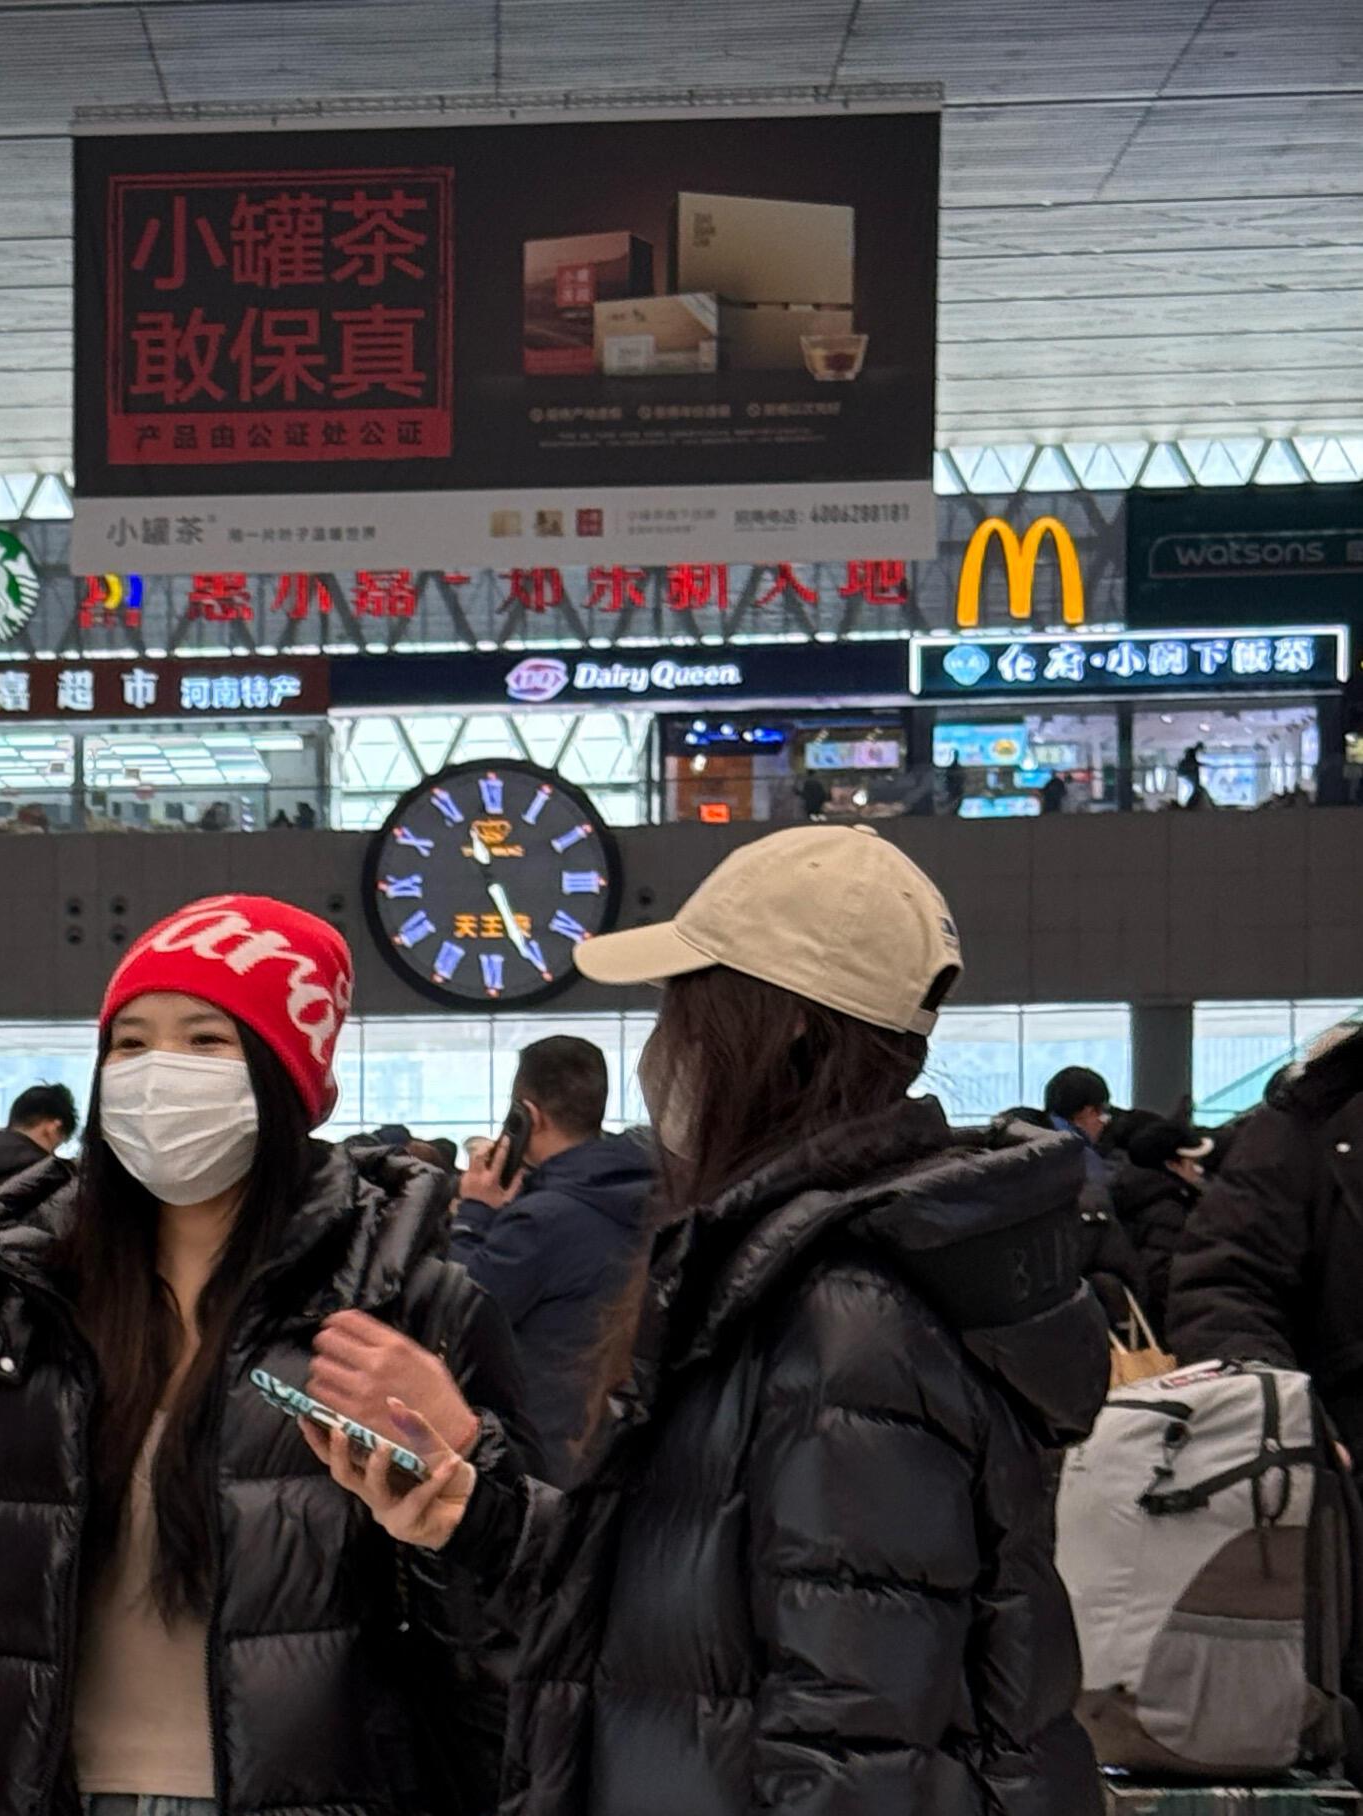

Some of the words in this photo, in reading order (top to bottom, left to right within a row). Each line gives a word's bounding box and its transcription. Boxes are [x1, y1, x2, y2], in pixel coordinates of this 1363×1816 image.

[129, 189, 429, 291] 小罐茶
[127, 303, 428, 404] 敢保真
[134, 419, 425, 452] 产品由公证处公证
[106, 515, 206, 548] 小罐茶
[1175, 540, 1327, 567] watsons
[179, 674, 302, 710] 河南特产
[573, 662, 648, 693] Dairy
[650, 660, 743, 690] Queen
